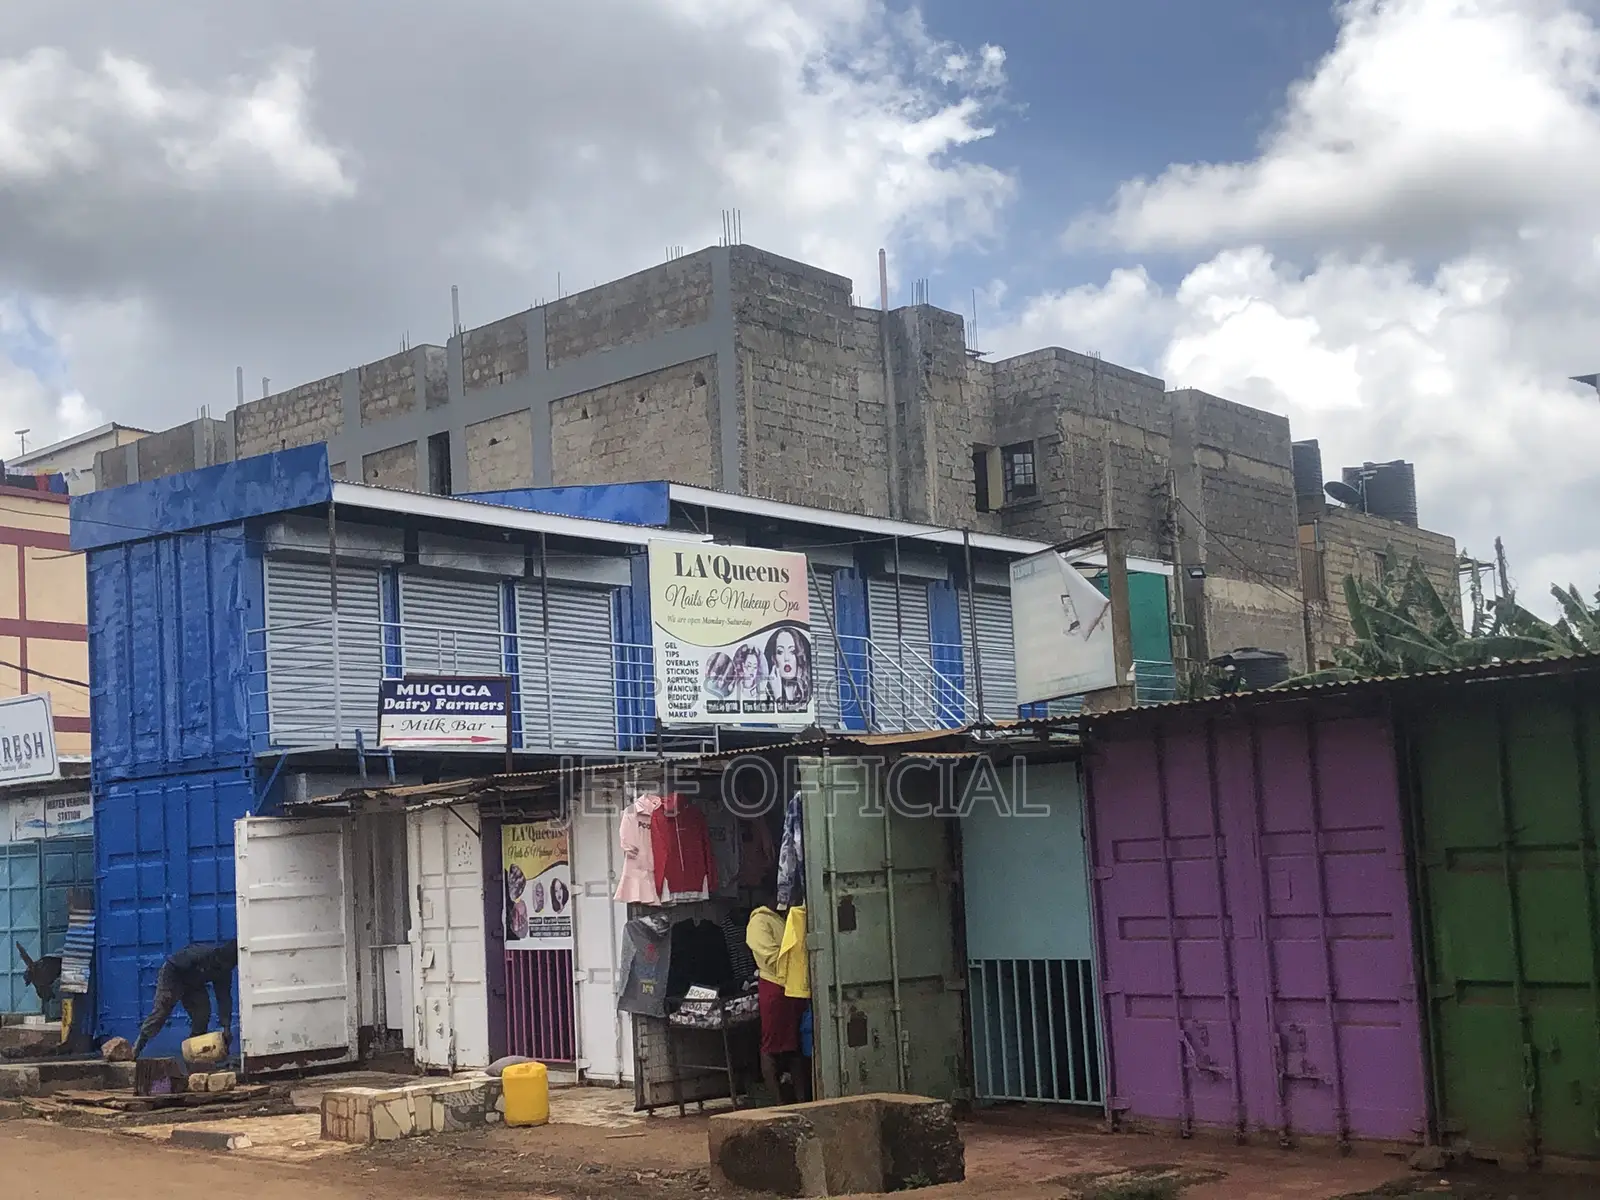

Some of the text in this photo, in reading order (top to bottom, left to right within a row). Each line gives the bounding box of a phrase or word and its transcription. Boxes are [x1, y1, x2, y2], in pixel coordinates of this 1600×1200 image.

[674, 552, 790, 584] LA'Queens
[665, 584, 800, 617] Nails & Makeup Spa
[687, 617, 701, 626] open
[396, 684, 491, 696] MUGUGA
[384, 698, 505, 712] Dairy Farmers
[400, 718, 486, 733] Milk Bar
